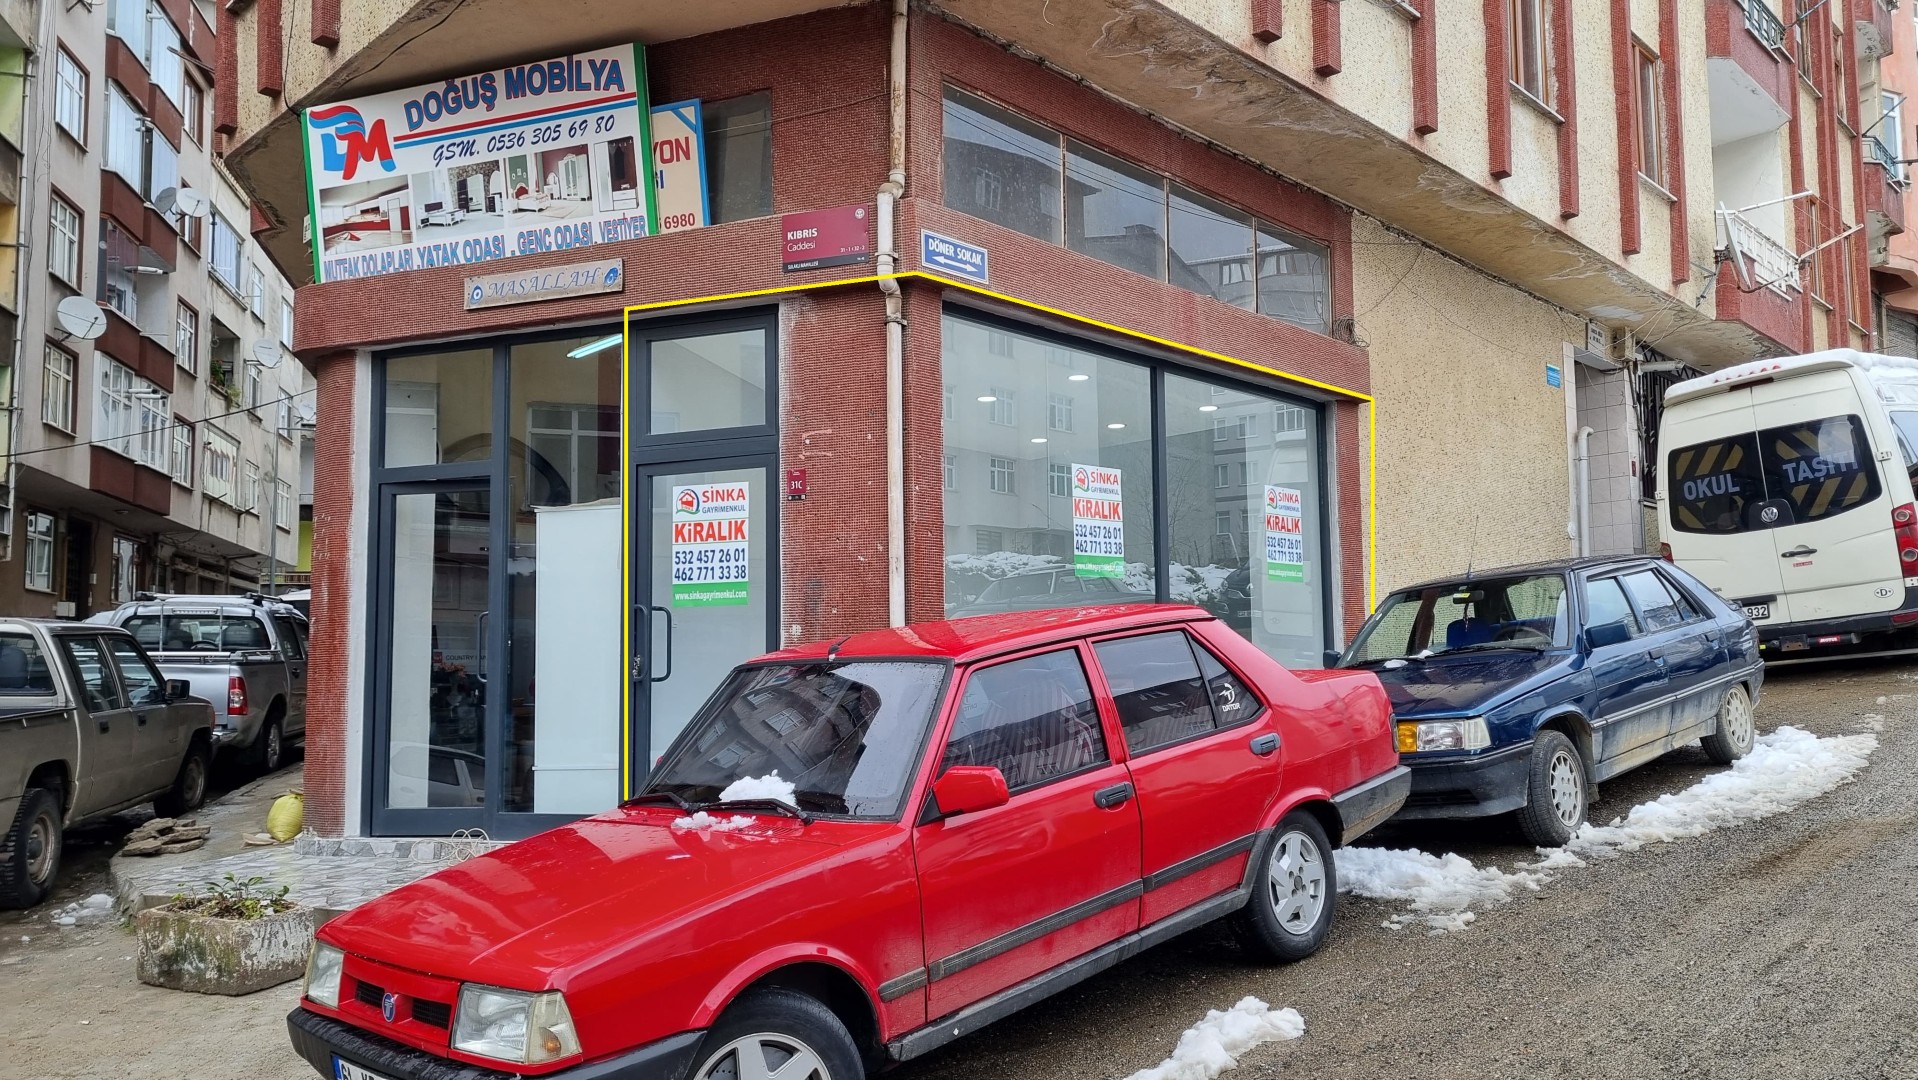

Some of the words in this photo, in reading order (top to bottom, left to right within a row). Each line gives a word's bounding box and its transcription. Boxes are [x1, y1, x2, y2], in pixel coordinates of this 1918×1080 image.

[404, 72, 498, 132] DOĞUŞ
[504, 54, 625, 100] MOBİLYA
[487, 131, 525, 153] 0536
[531, 124, 562, 145] 305
[568, 119, 588, 138] 69
[595, 114, 615, 133] 80
[787, 228, 818, 240] KIBRIS
[324, 255, 361, 281] MUTFAK
[362, 248, 413, 279] DOLAPLARI
[599, 213, 647, 242] VESTİYER
[787, 240, 816, 252] Caddesi
[928, 238, 955, 257] DÖNER
[957, 247, 982, 265] SOKAK
[791, 480, 802, 489] 31C
[1090, 469, 1119, 486] SİNKA
[702, 486, 746, 503] SİNKA
[1683, 473, 1741, 500] OKUL
[1278, 489, 1299, 505] SİNKA
[702, 505, 746, 514] GAYRİMENKUL
[1075, 524, 1087, 537] 532
[1089, 525, 1101, 538] 457
[1103, 526, 1111, 539] 26
[1113, 527, 1121, 540] 01
[1075, 540, 1088, 553] 462
[1089, 540, 1102, 554] 771
[1104, 541, 1112, 554] 33
[1114, 542, 1122, 555] 38
[1267, 536, 1276, 548] 532
[1277, 537, 1286, 549] 457
[1288, 538, 1294, 550] 26
[1295, 539, 1301, 550] 01
[675, 551, 694, 565] 532
[697, 550, 716, 564] 457
[718, 549, 731, 563] 26
[734, 548, 745, 562] 01
[1267, 549, 1276, 560] 462
[1278, 550, 1286, 561] 771
[1288, 551, 1294, 562] 33
[1295, 552, 1302, 563] 38
[674, 567, 694, 581] 462
[697, 566, 715, 580] 771
[718, 566, 731, 580] 33
[734, 565, 746, 579] 38
[675, 589, 747, 601] www.sinkagayrimenkul.com
